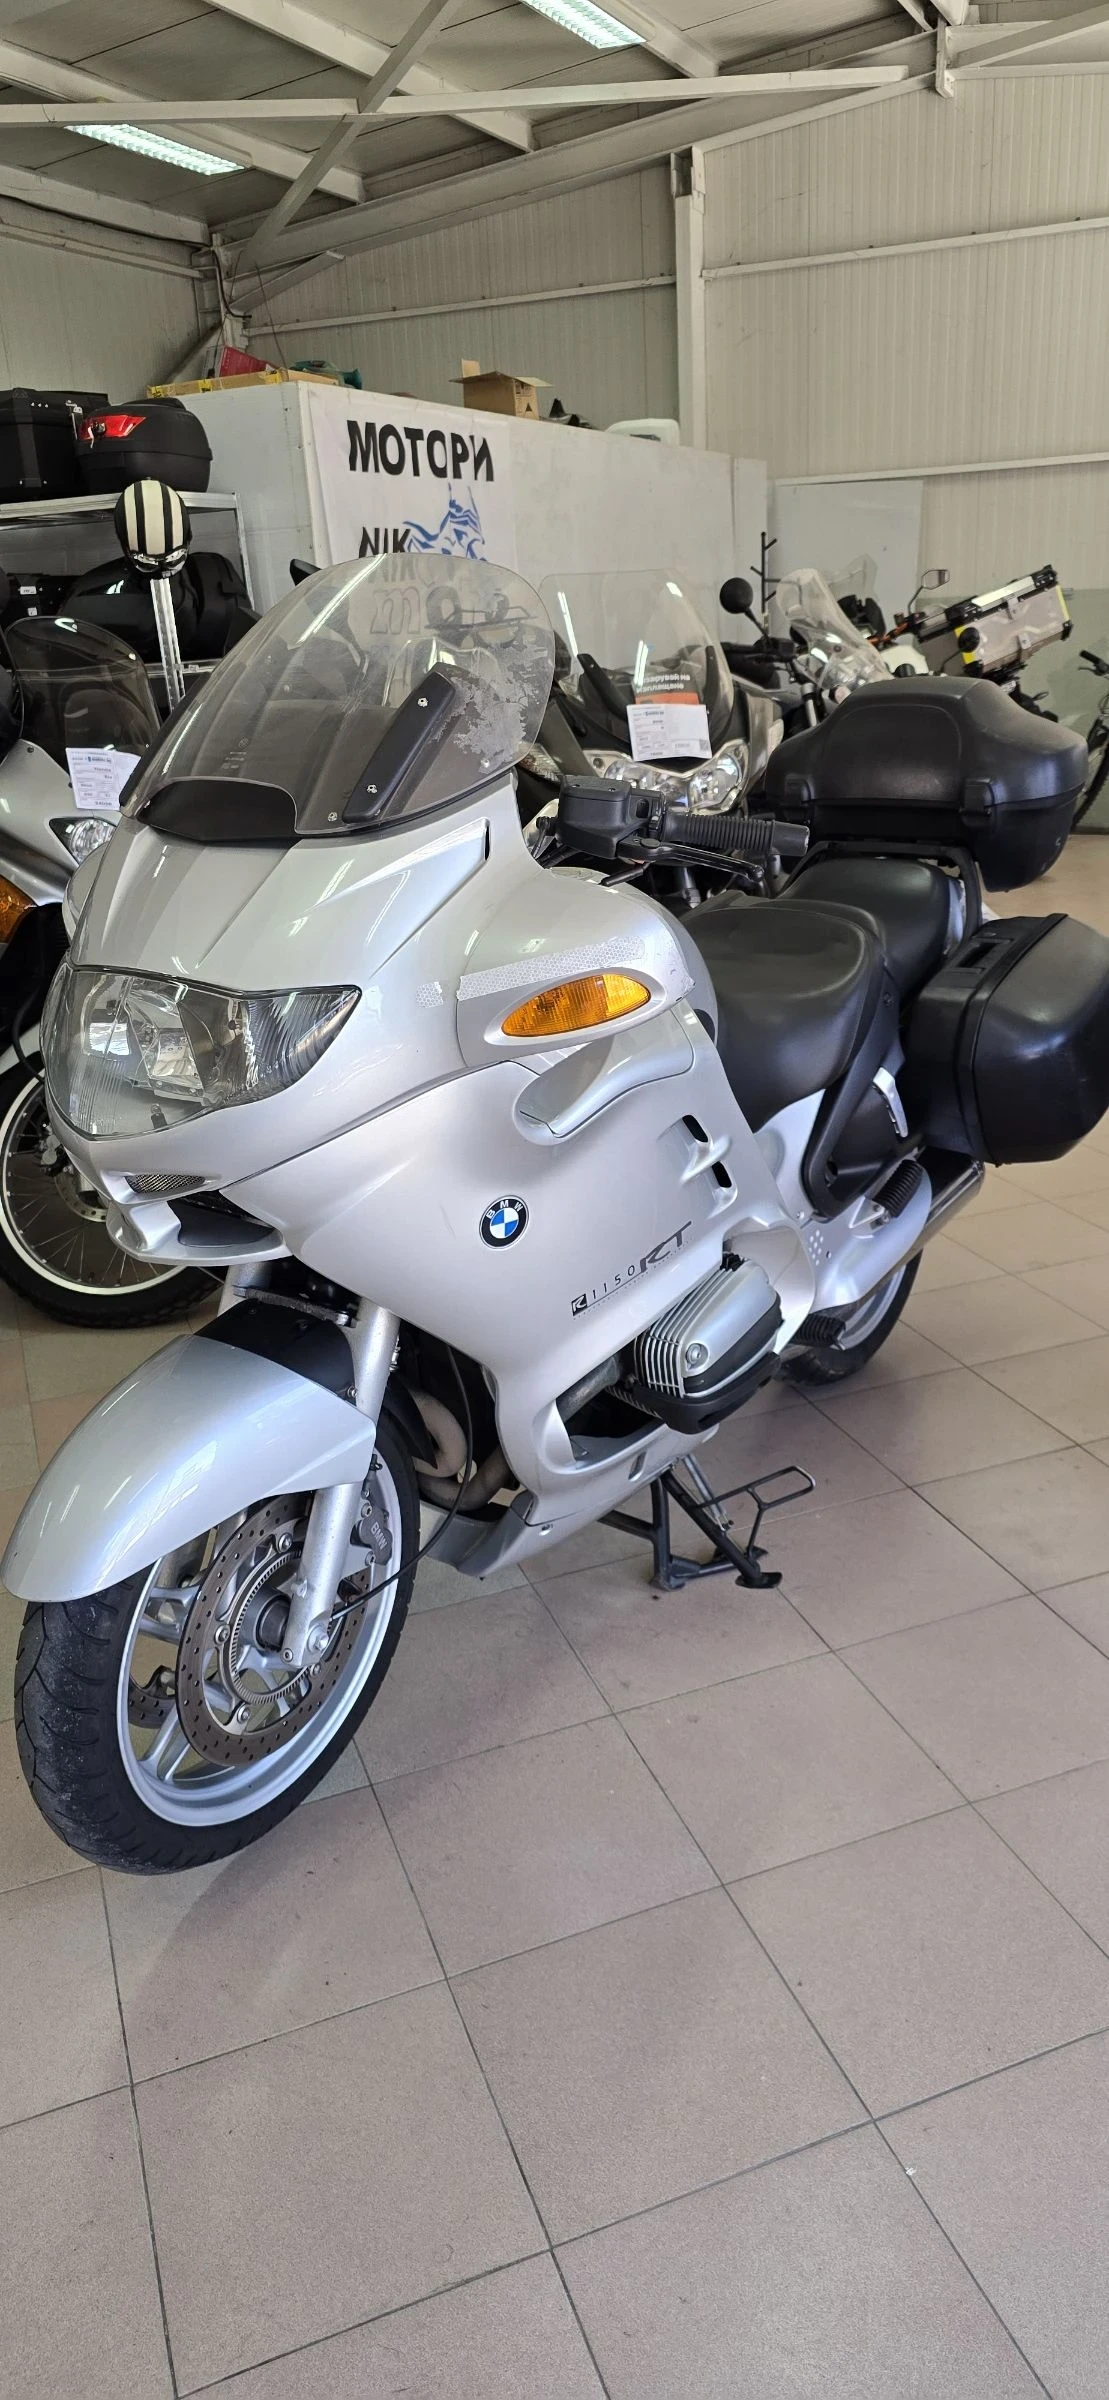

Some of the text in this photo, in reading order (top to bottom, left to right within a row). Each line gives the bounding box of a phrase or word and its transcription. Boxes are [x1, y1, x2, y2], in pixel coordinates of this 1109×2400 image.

[347, 420, 494, 482] МОТОРИ
[486, 1199, 524, 1219] BMW
[370, 1521, 388, 1550] BMW
